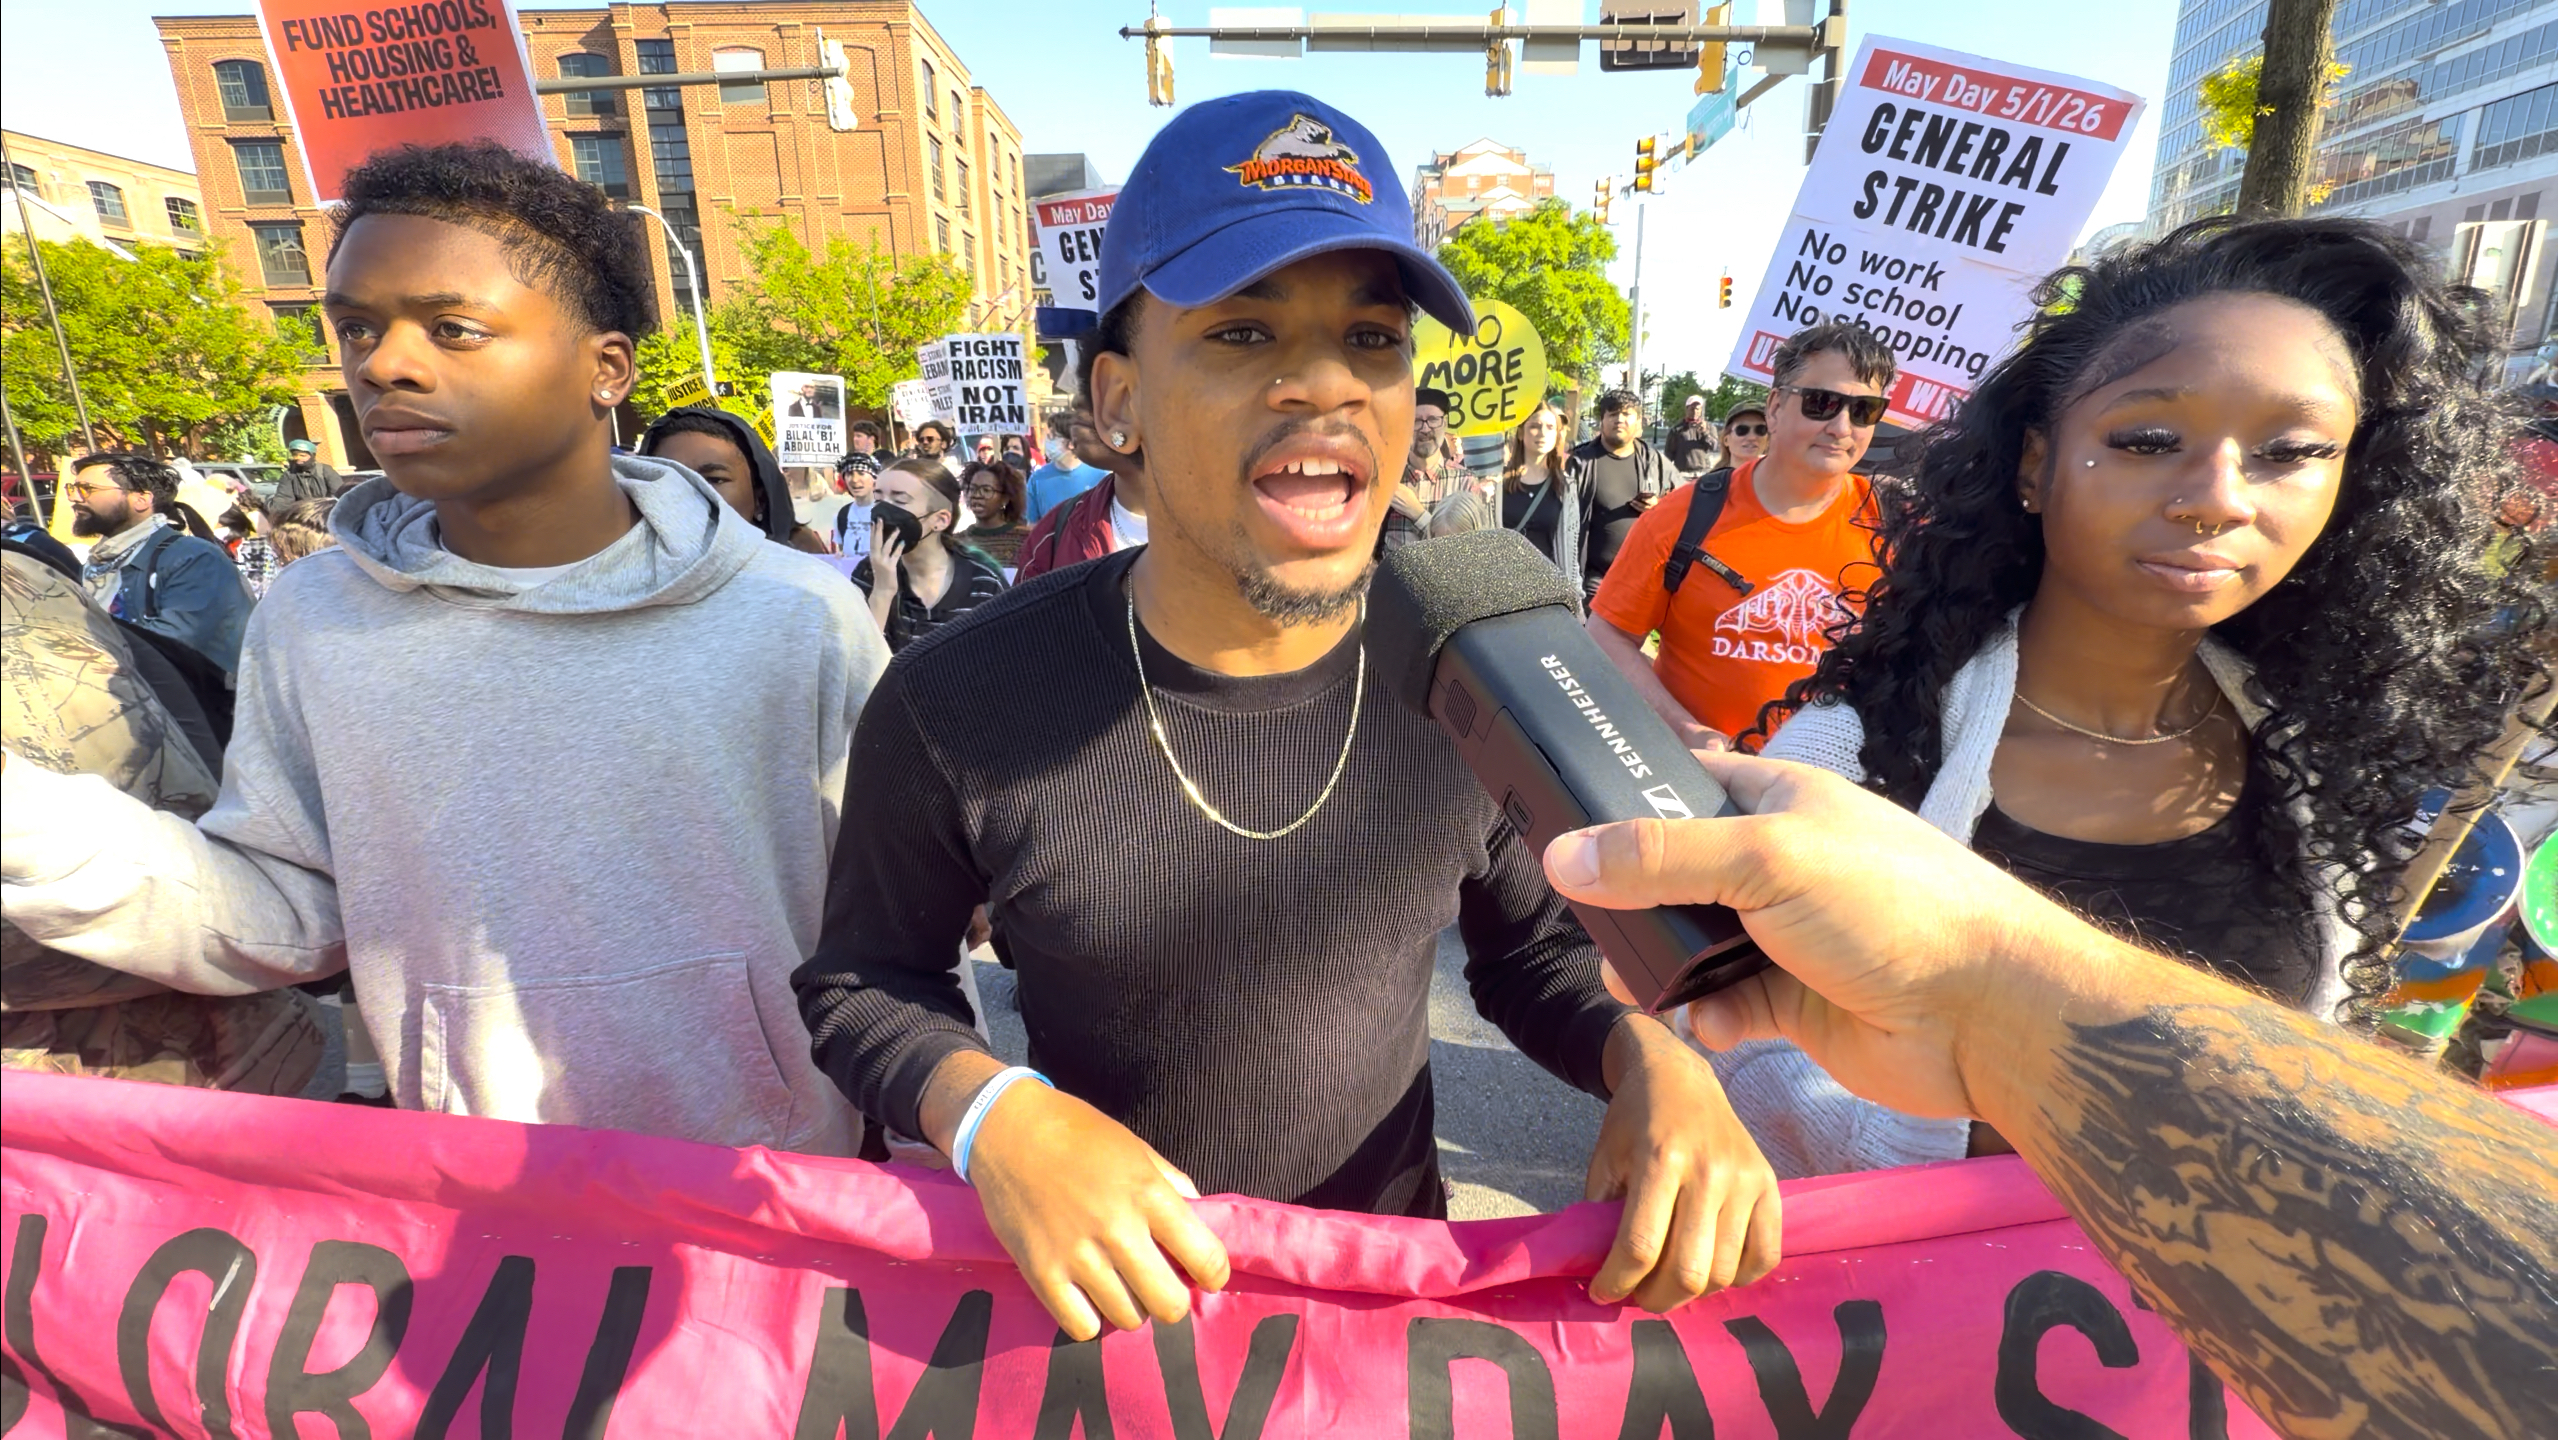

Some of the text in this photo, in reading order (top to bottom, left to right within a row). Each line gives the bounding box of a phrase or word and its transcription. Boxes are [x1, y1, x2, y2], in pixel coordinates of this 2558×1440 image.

[282, 0, 497, 51] FUND SCHOOLS,
[325, 34, 480, 84] HOUSING &
[319, 66, 504, 119] HEALTHCARE!
[1882, 59, 2106, 134] May Day 5/1/26
[1860, 102, 2071, 197] GENERAL
[1051, 205, 1081, 225] May
[1853, 169, 2026, 254] STRIKE
[1798, 229, 1946, 292] No work
[1079, 269, 1100, 301] S
[1785, 261, 1964, 332] No school
[1773, 291, 1820, 327] No
[949, 340, 1020, 357] FIGHT
[951, 359, 1023, 380] RACISM
[1420, 347, 1525, 389] MORE
[667, 378, 701, 403] JUSTICE
[962, 385, 1018, 405] NOT
[1448, 385, 1519, 429] BGE
[1905, 380, 1970, 418] WI
[786, 429, 815, 441] BILAL
[958, 405, 1025, 424] IRAN
[784, 441, 840, 453] ABDULLAH
[1541, 654, 1653, 779] SENNHEISER
[0, 1213, 2227, 1440] LOBAL MAY DAY S
